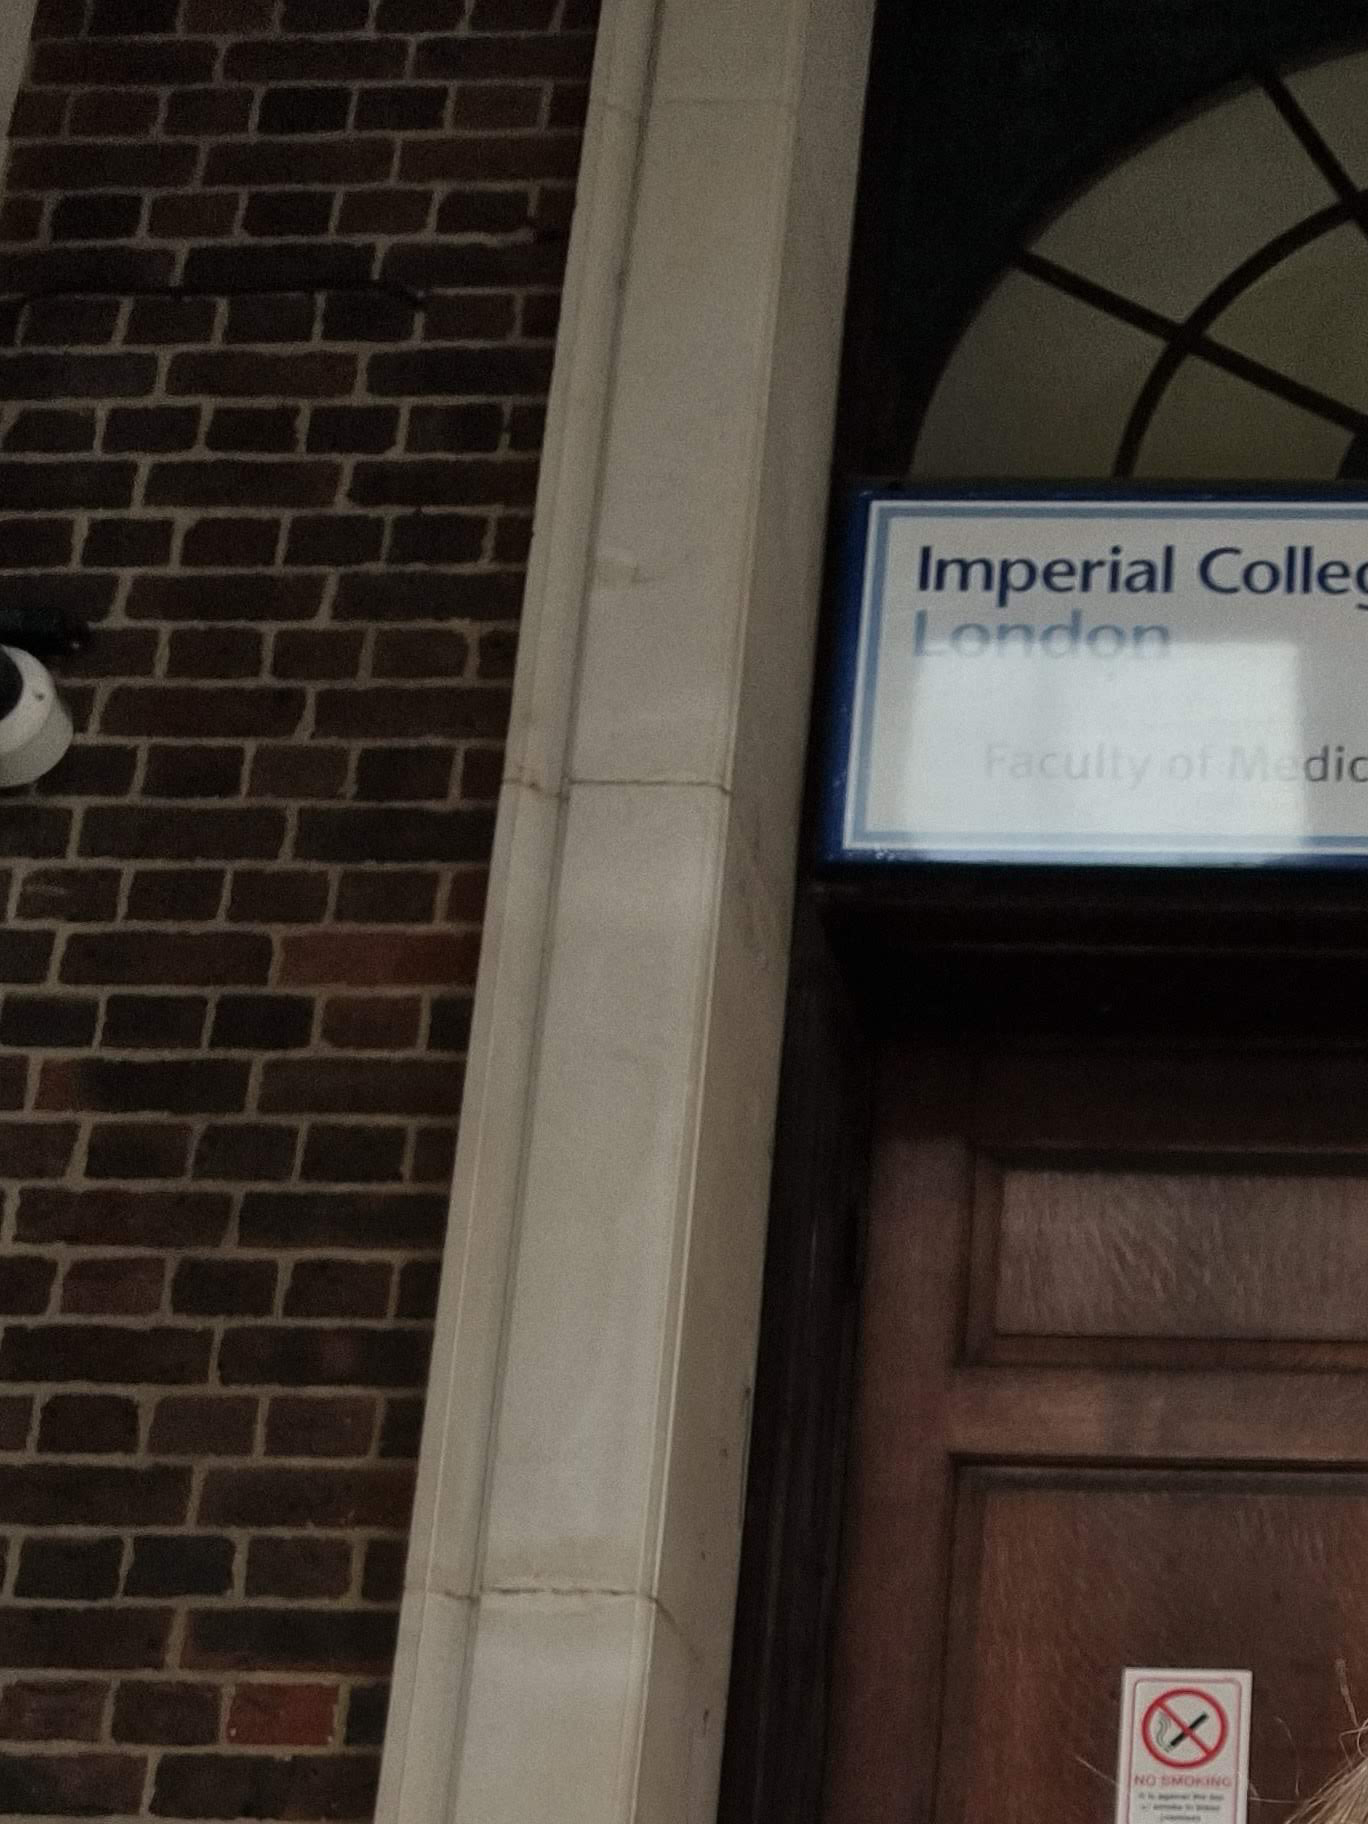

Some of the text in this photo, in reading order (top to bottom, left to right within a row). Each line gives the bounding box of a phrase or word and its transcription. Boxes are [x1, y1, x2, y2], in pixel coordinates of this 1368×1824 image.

[917, 545, 1175, 608] Imperial
[913, 608, 1172, 659] London
[984, 743, 1151, 791] Faculty
[1167, 742, 1214, 781] of
[1134, 1775, 1232, 1787] NO SMOKING
